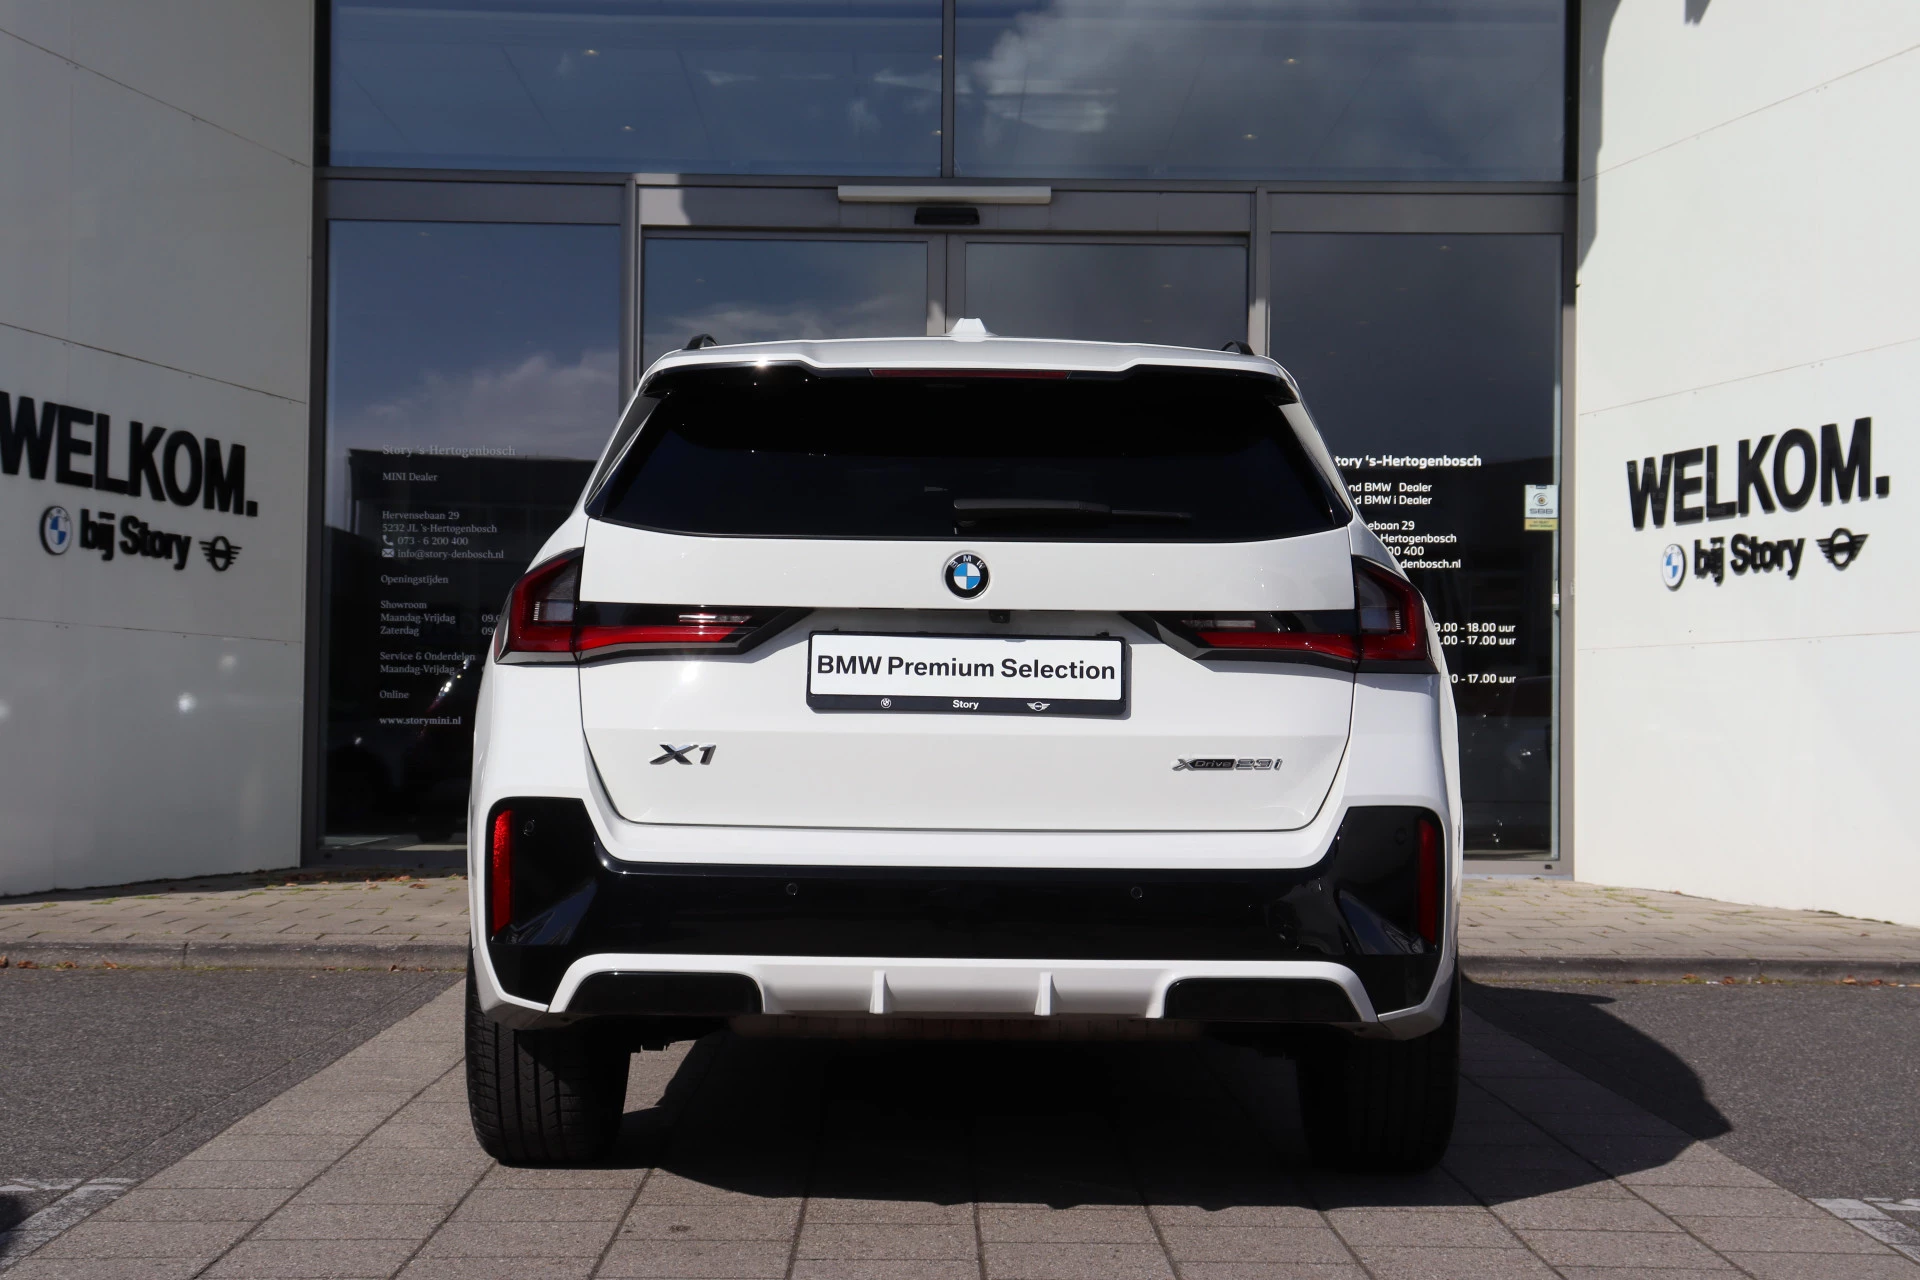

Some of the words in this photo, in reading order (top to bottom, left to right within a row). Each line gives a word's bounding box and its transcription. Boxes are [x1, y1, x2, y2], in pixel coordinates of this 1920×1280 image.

[0, 391, 258, 517] WELKOM.
[382, 444, 413, 457] Story
[1335, 455, 1363, 469] tory
[382, 473, 406, 481] MINI
[408, 473, 438, 482] Dealer
[1626, 417, 1890, 531] WELKOM.
[1349, 482, 1362, 492] nd
[1364, 482, 1392, 492] BMW
[1399, 482, 1432, 492] Dealer
[1364, 495, 1392, 505] BMW
[1393, 495, 1397, 505] i
[1399, 495, 1432, 505] Dealer
[382, 511, 446, 520] Hervensebaan
[448, 511, 460, 520] 29
[382, 524, 404, 533] 5232
[407, 524, 418, 533] JL
[1367, 521, 1399, 531] ebaan
[1401, 521, 1415, 530] 29
[80, 508, 115, 561] bij
[119, 515, 192, 570] Story
[397, 537, 415, 545] 073
[423, 537, 429, 545] 6
[432, 537, 449, 545] 200
[451, 537, 469, 546] 400
[1379, 534, 1457, 545] Hertogenbosch
[397, 549, 504, 560] info@story-denbosch.nl
[1387, 546, 1401, 556] 00
[1403, 546, 1425, 556] 400
[1400, 559, 1462, 569] denbosch.nl
[1694, 537, 1725, 585] bij
[1730, 533, 1806, 580] Story
[381, 575, 449, 586] Openingstijden
[380, 601, 427, 609] Showroom
[380, 613, 456, 624] Maandag-Vrijdag
[380, 626, 419, 637] Zaterdag
[481, 627, 495, 636] 09
[1433, 622, 1458, 632] 9.00
[1467, 622, 1496, 632] 18.00
[1498, 625, 1516, 633] uur
[1440, 635, 1458, 645] .00
[380, 652, 413, 661] Service
[415, 652, 422, 661] &
[380, 664, 455, 675] Maandag-Vrijdag
[817, 655, 882, 675] BMW
[887, 656, 994, 678] Premium
[1001, 658, 1115, 680] Selection
[1498, 676, 1516, 684] uur
[379, 690, 409, 699] Online
[952, 699, 979, 710] Story
[379, 717, 461, 727] www.storymini.nl
[649, 743, 717, 766] X1
